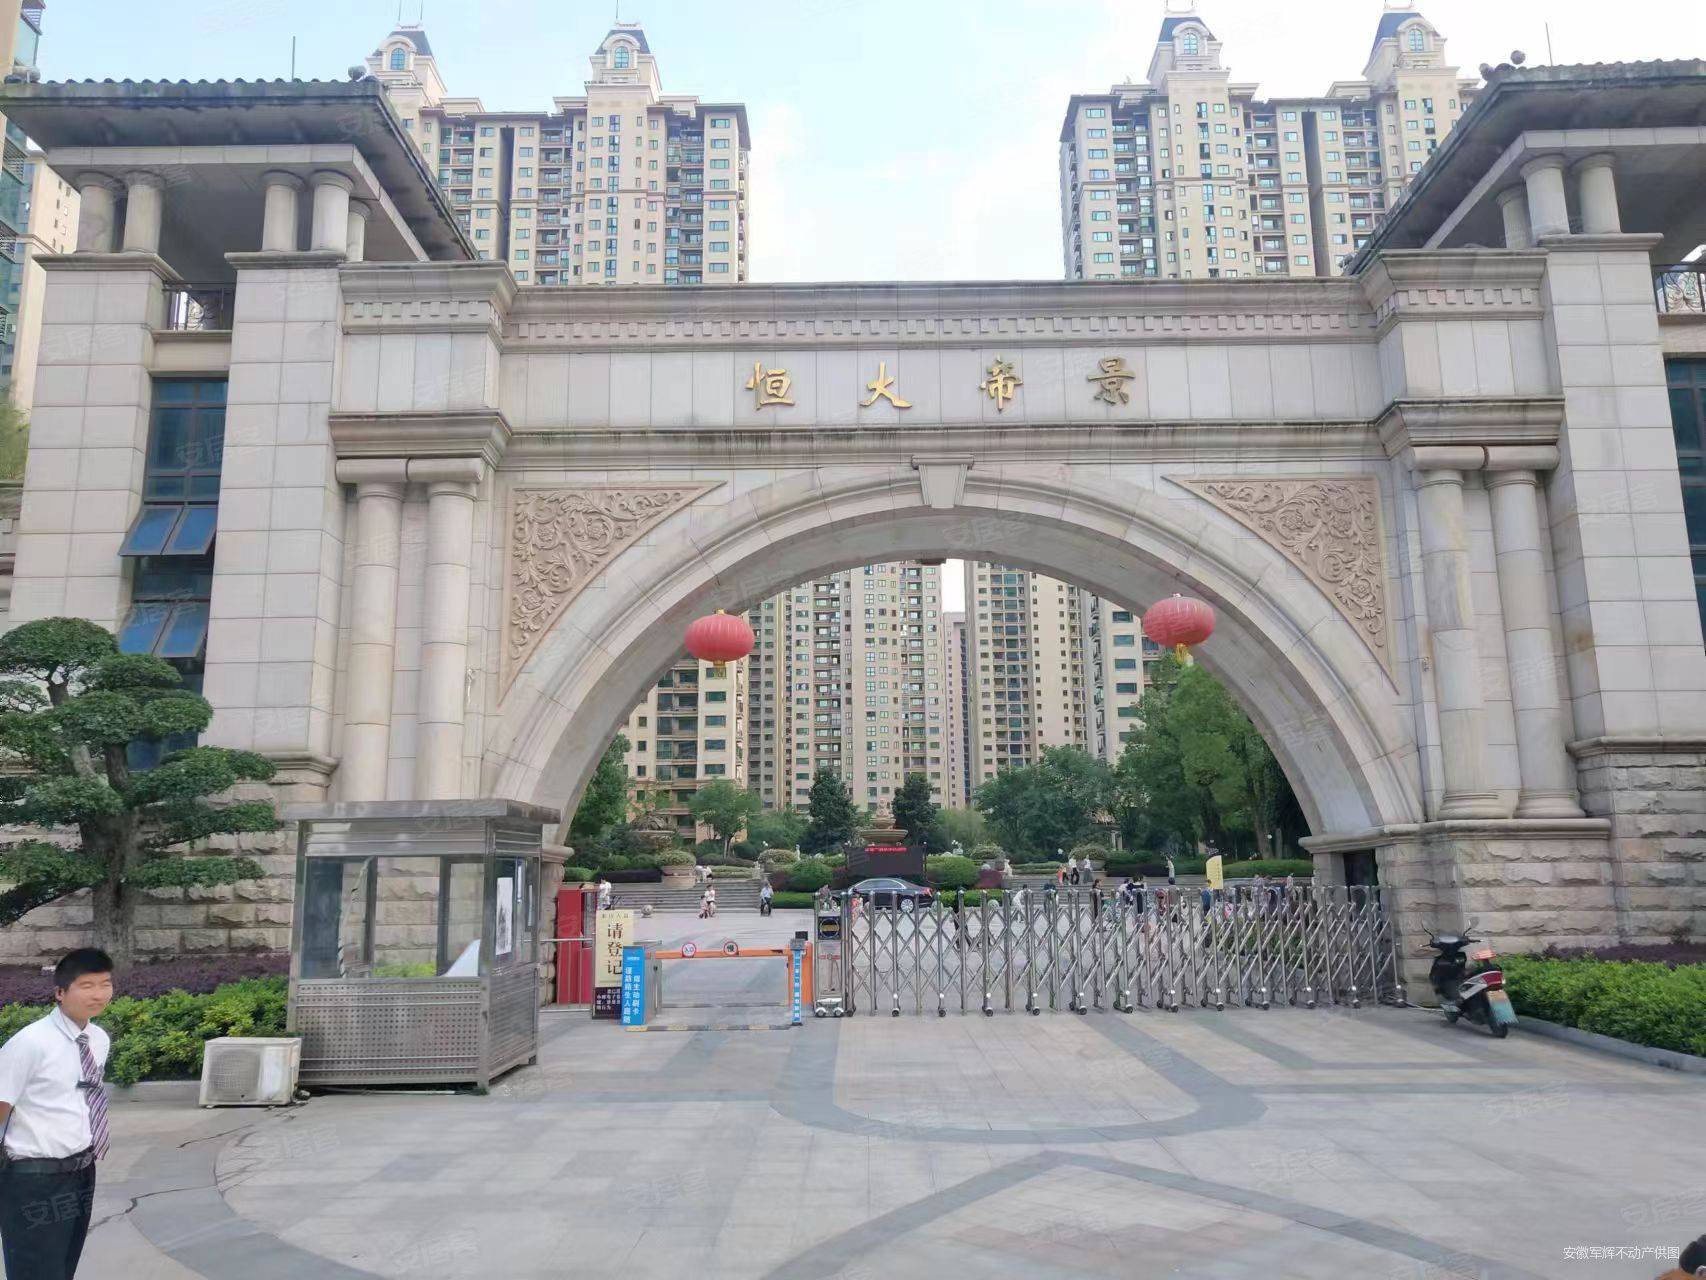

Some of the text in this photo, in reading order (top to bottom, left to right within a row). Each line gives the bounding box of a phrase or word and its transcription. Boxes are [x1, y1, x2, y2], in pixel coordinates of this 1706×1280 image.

[746, 355, 1136, 413] 恒大帝景
[608, 922, 623, 975] 请登记
